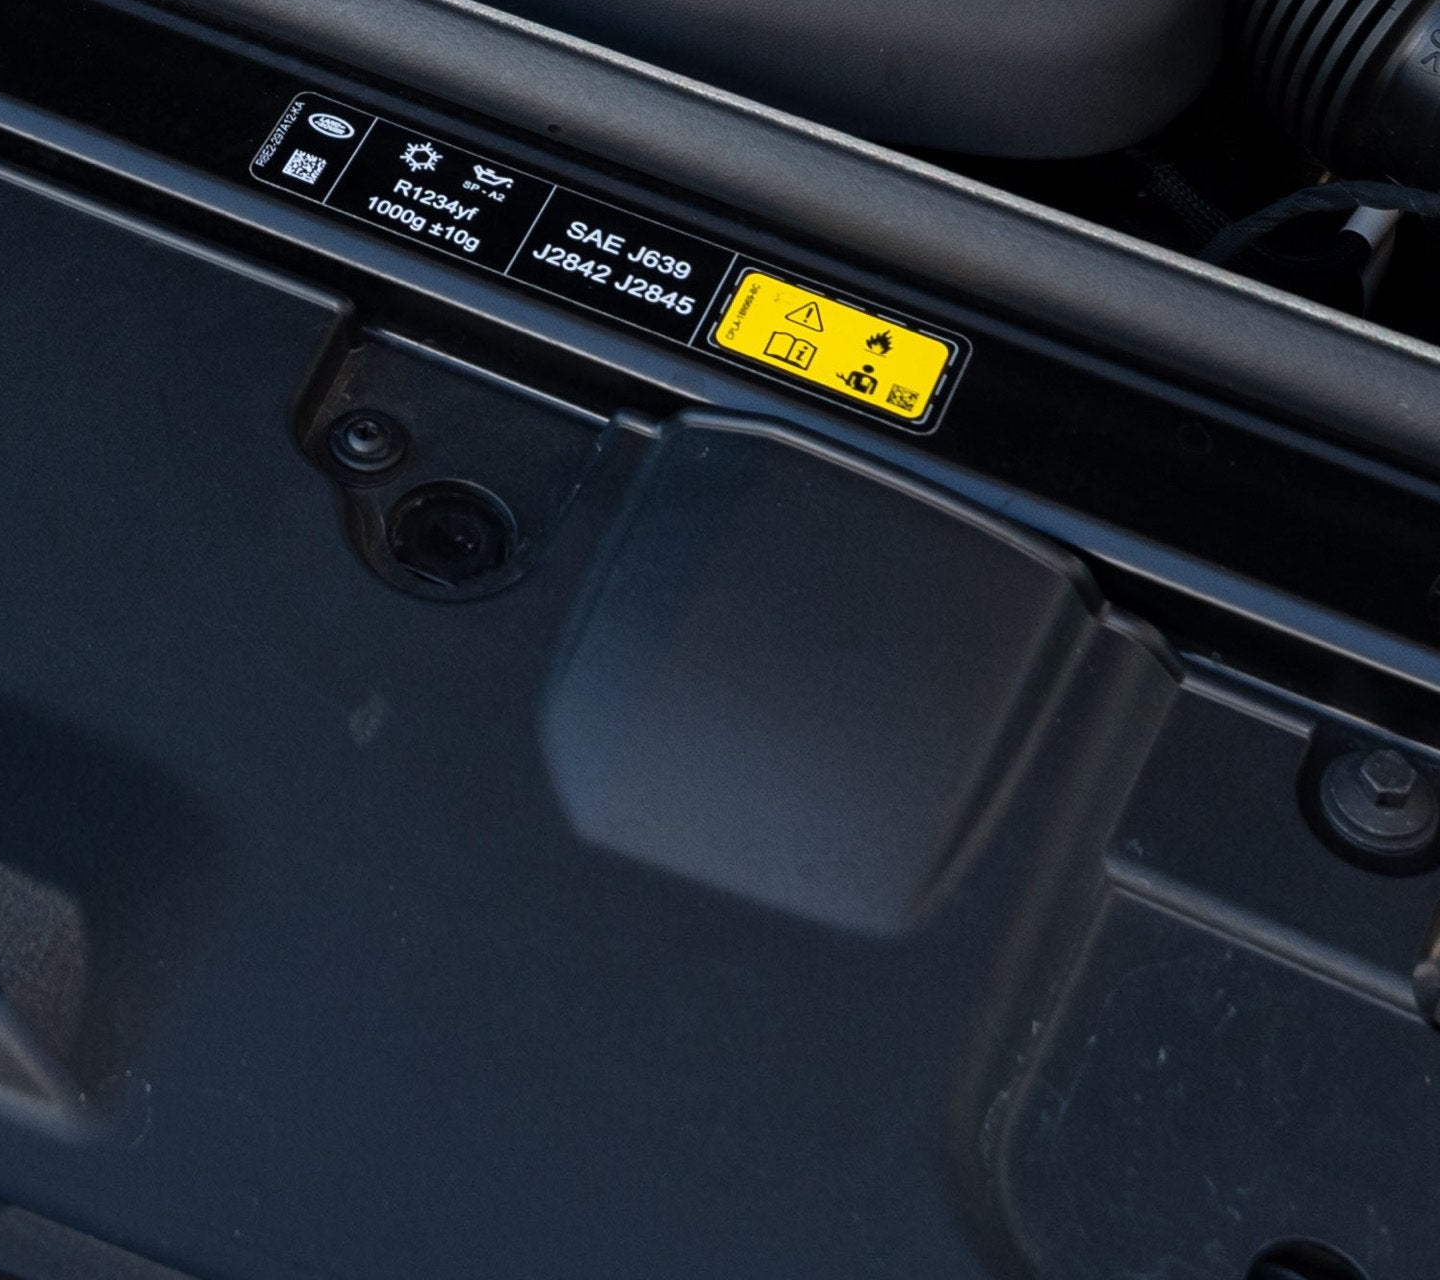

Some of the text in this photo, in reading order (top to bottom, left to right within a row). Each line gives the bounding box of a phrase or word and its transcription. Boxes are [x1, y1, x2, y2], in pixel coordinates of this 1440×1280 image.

[393, 178, 480, 221] R1234yf
[462, 180, 480, 192] SP
[488, 190, 506, 203] A2
[368, 196, 481, 252] 1000g ±10g
[566, 221, 692, 280] SAE J639
[532, 243, 696, 315] J2842 J2845
